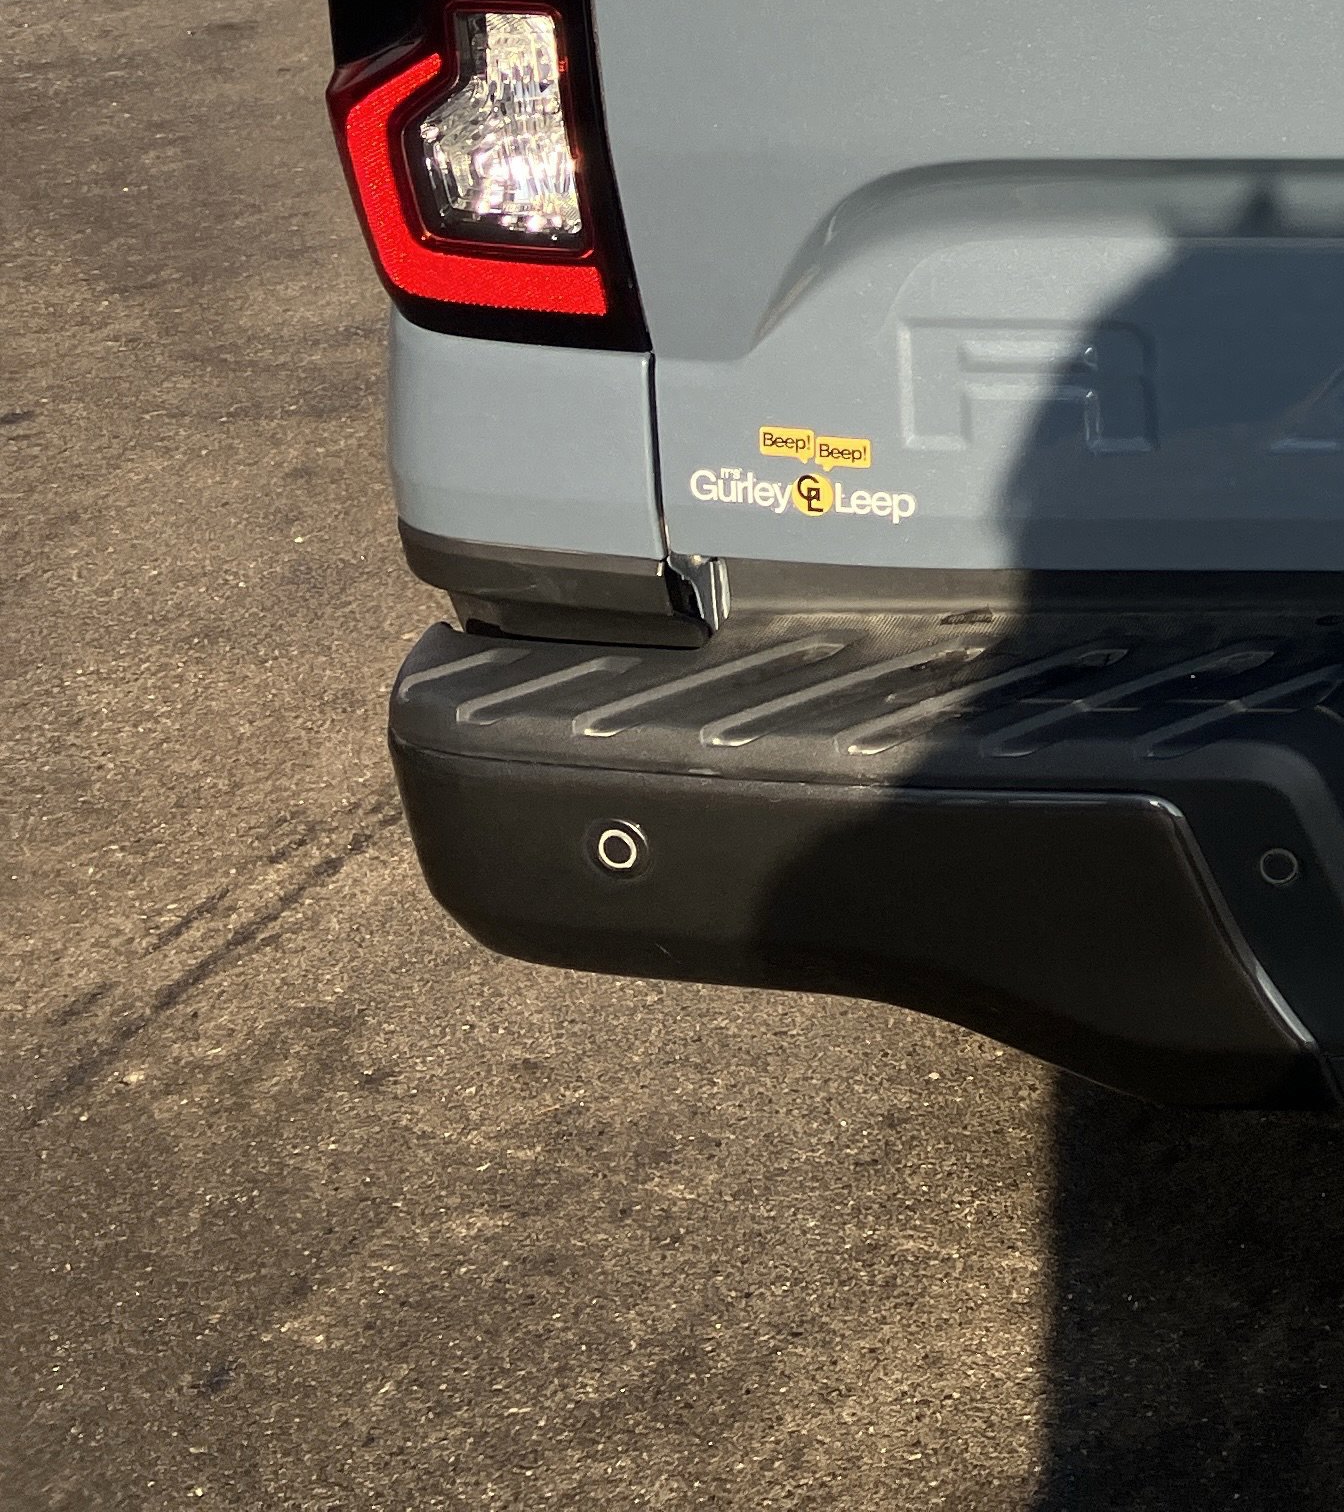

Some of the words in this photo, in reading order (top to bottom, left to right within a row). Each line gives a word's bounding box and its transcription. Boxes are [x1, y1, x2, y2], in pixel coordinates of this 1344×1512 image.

[762, 432, 811, 454] Beep!
[819, 444, 867, 463] Beep!
[690, 469, 794, 514] Gurley
[834, 482, 916, 525] Leep
